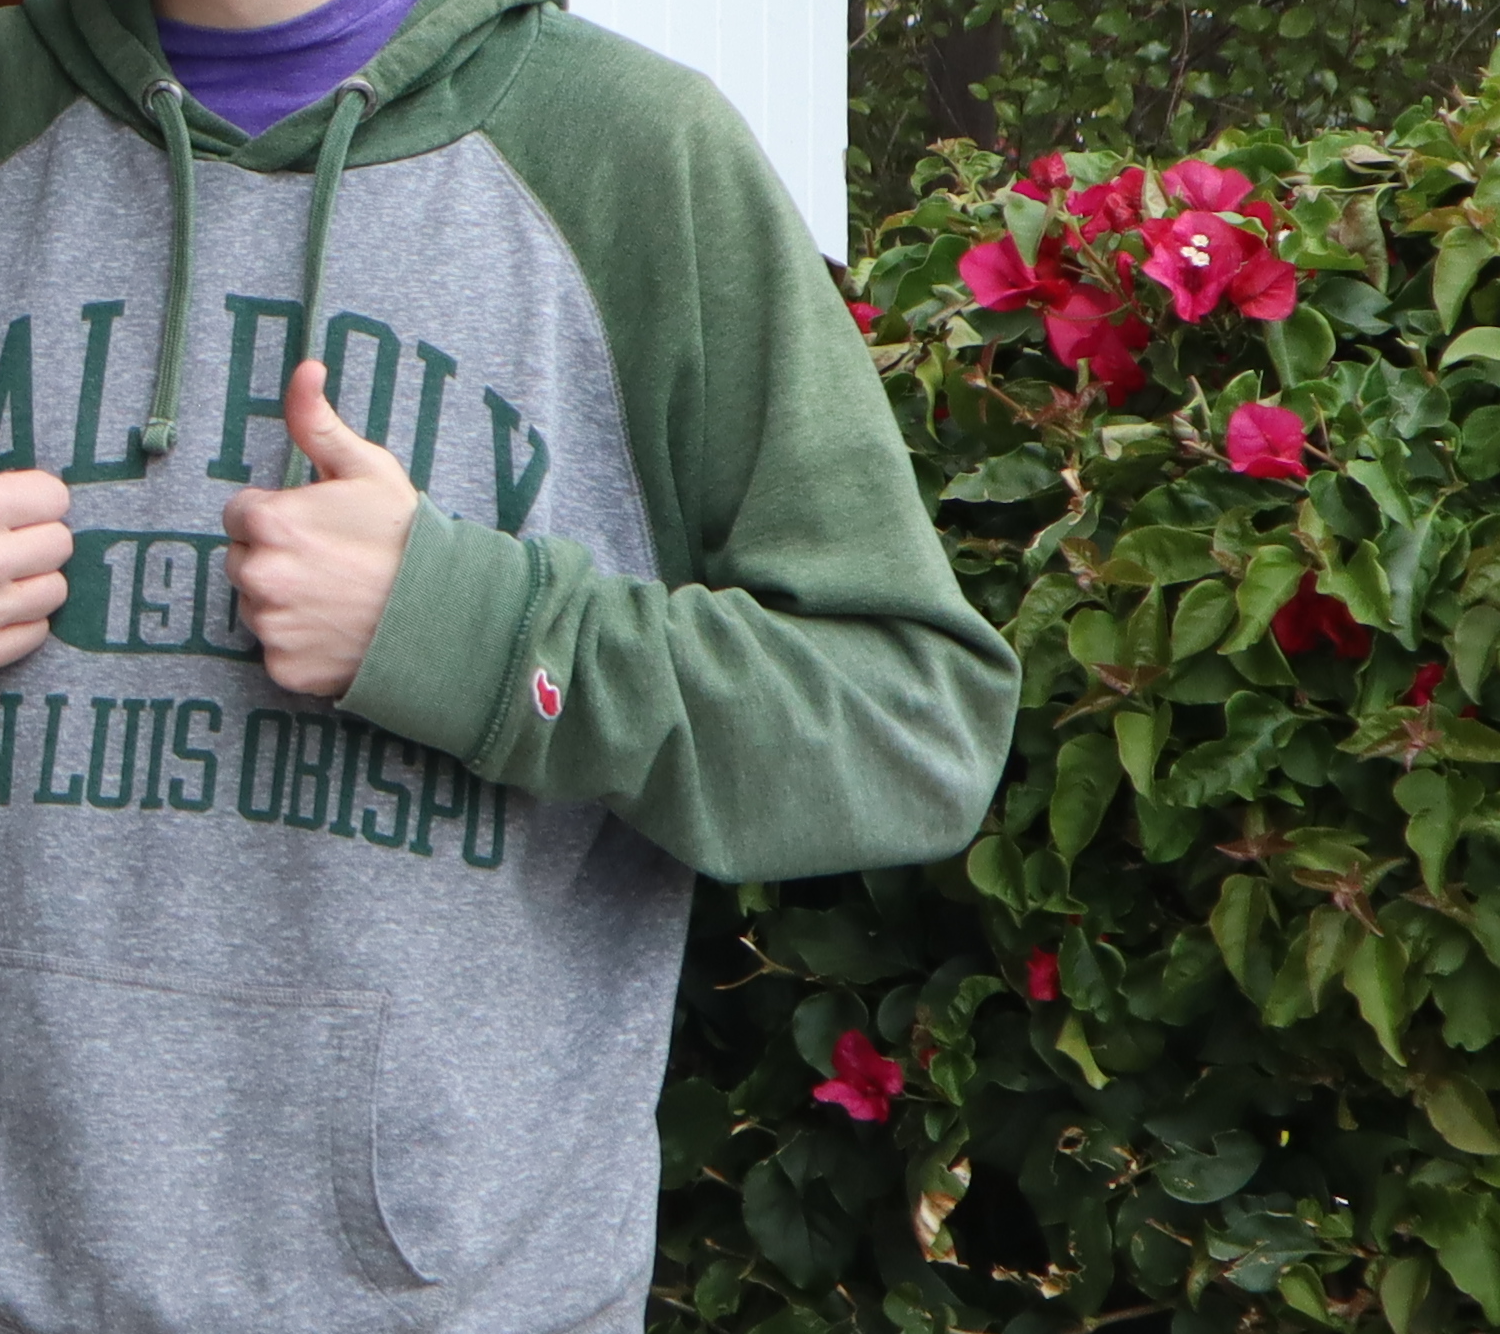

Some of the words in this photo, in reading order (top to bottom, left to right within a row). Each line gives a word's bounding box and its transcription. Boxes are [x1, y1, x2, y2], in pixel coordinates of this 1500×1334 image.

[207, 292, 551, 539] POLY
[32, 693, 223, 813] LUIS
[239, 705, 508, 872] OBISPO
